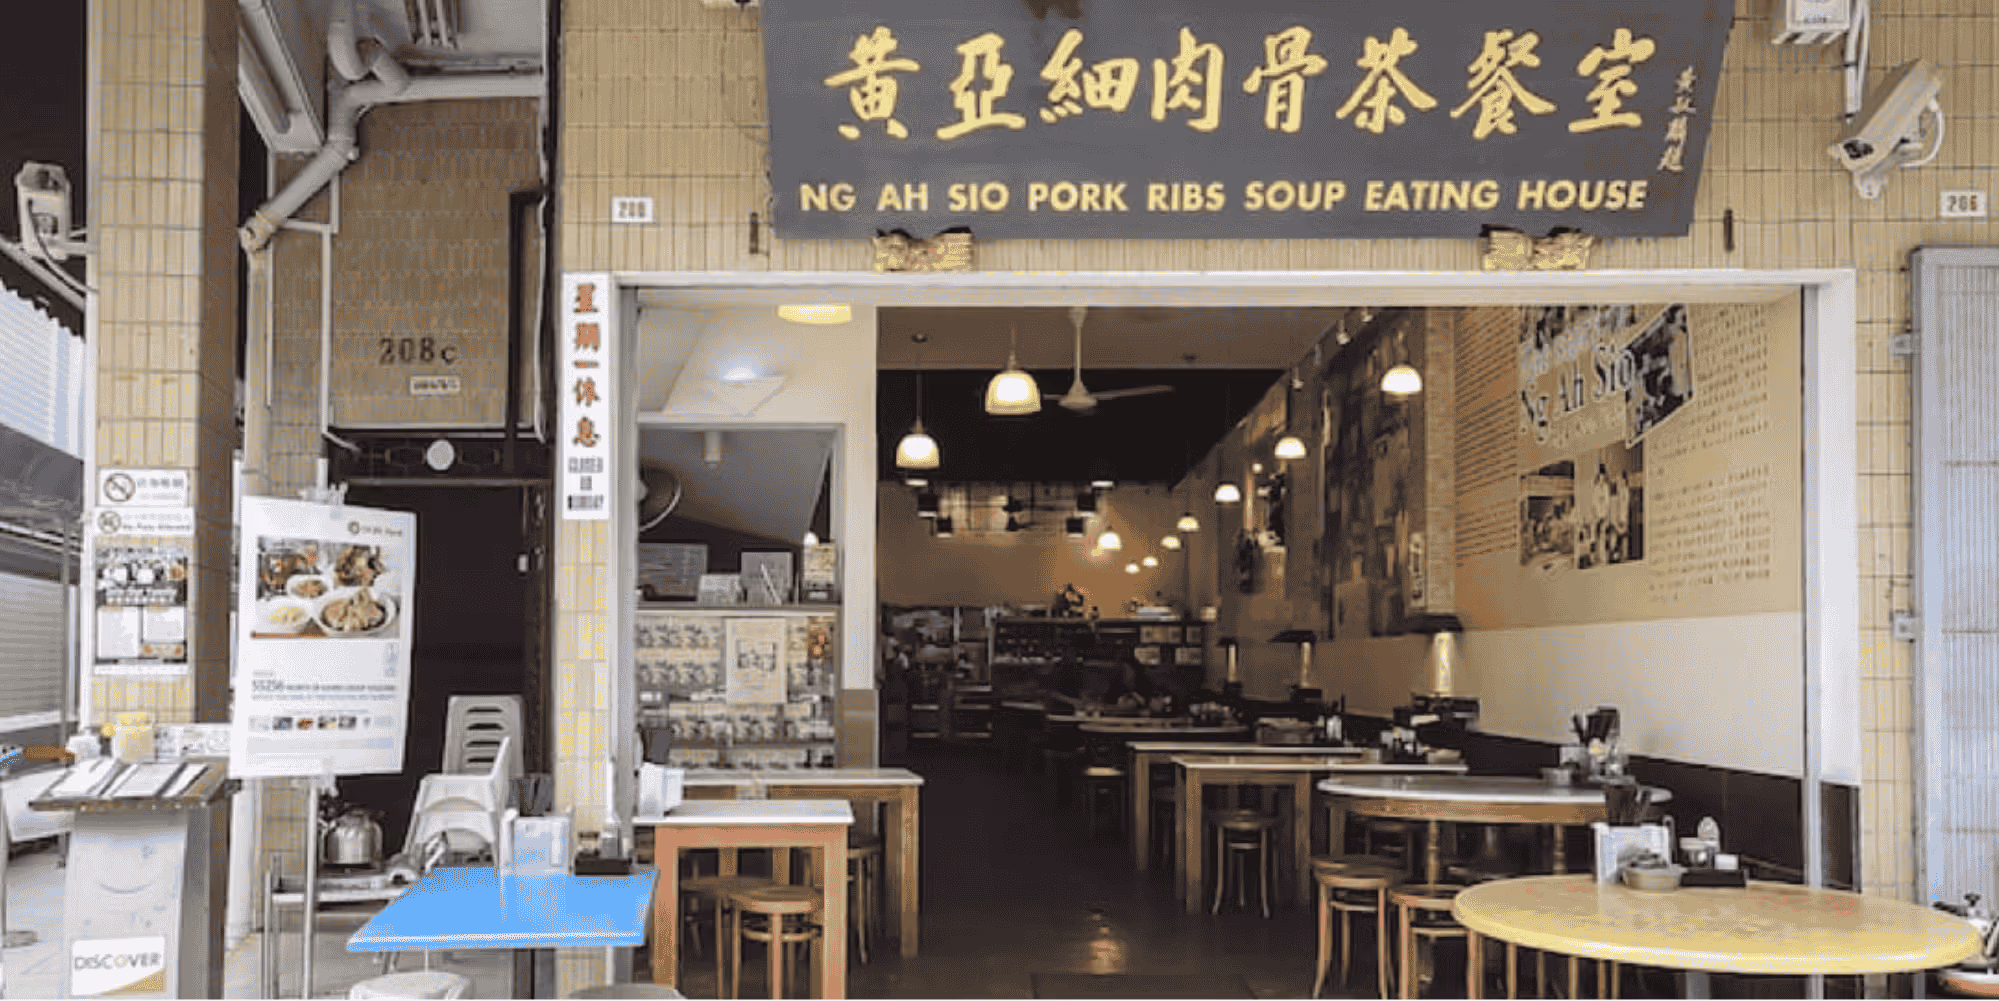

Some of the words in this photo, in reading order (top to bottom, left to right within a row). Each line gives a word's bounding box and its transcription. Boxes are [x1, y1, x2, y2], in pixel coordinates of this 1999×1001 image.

[799, 182, 857, 212] NG
[875, 182, 930, 212] AH
[947, 181, 1010, 212] SIO
[1027, 180, 1129, 212] PORK
[1146, 181, 1226, 212] RIBS
[1244, 180, 1346, 211] SOUP
[1364, 179, 1500, 211] EATING
[1516, 180, 1649, 211] HOUSE
[571, 282, 602, 448] 星期一休息
[1554, 358, 1586, 414] Ah
[74, 953, 163, 970] DISCOVER
